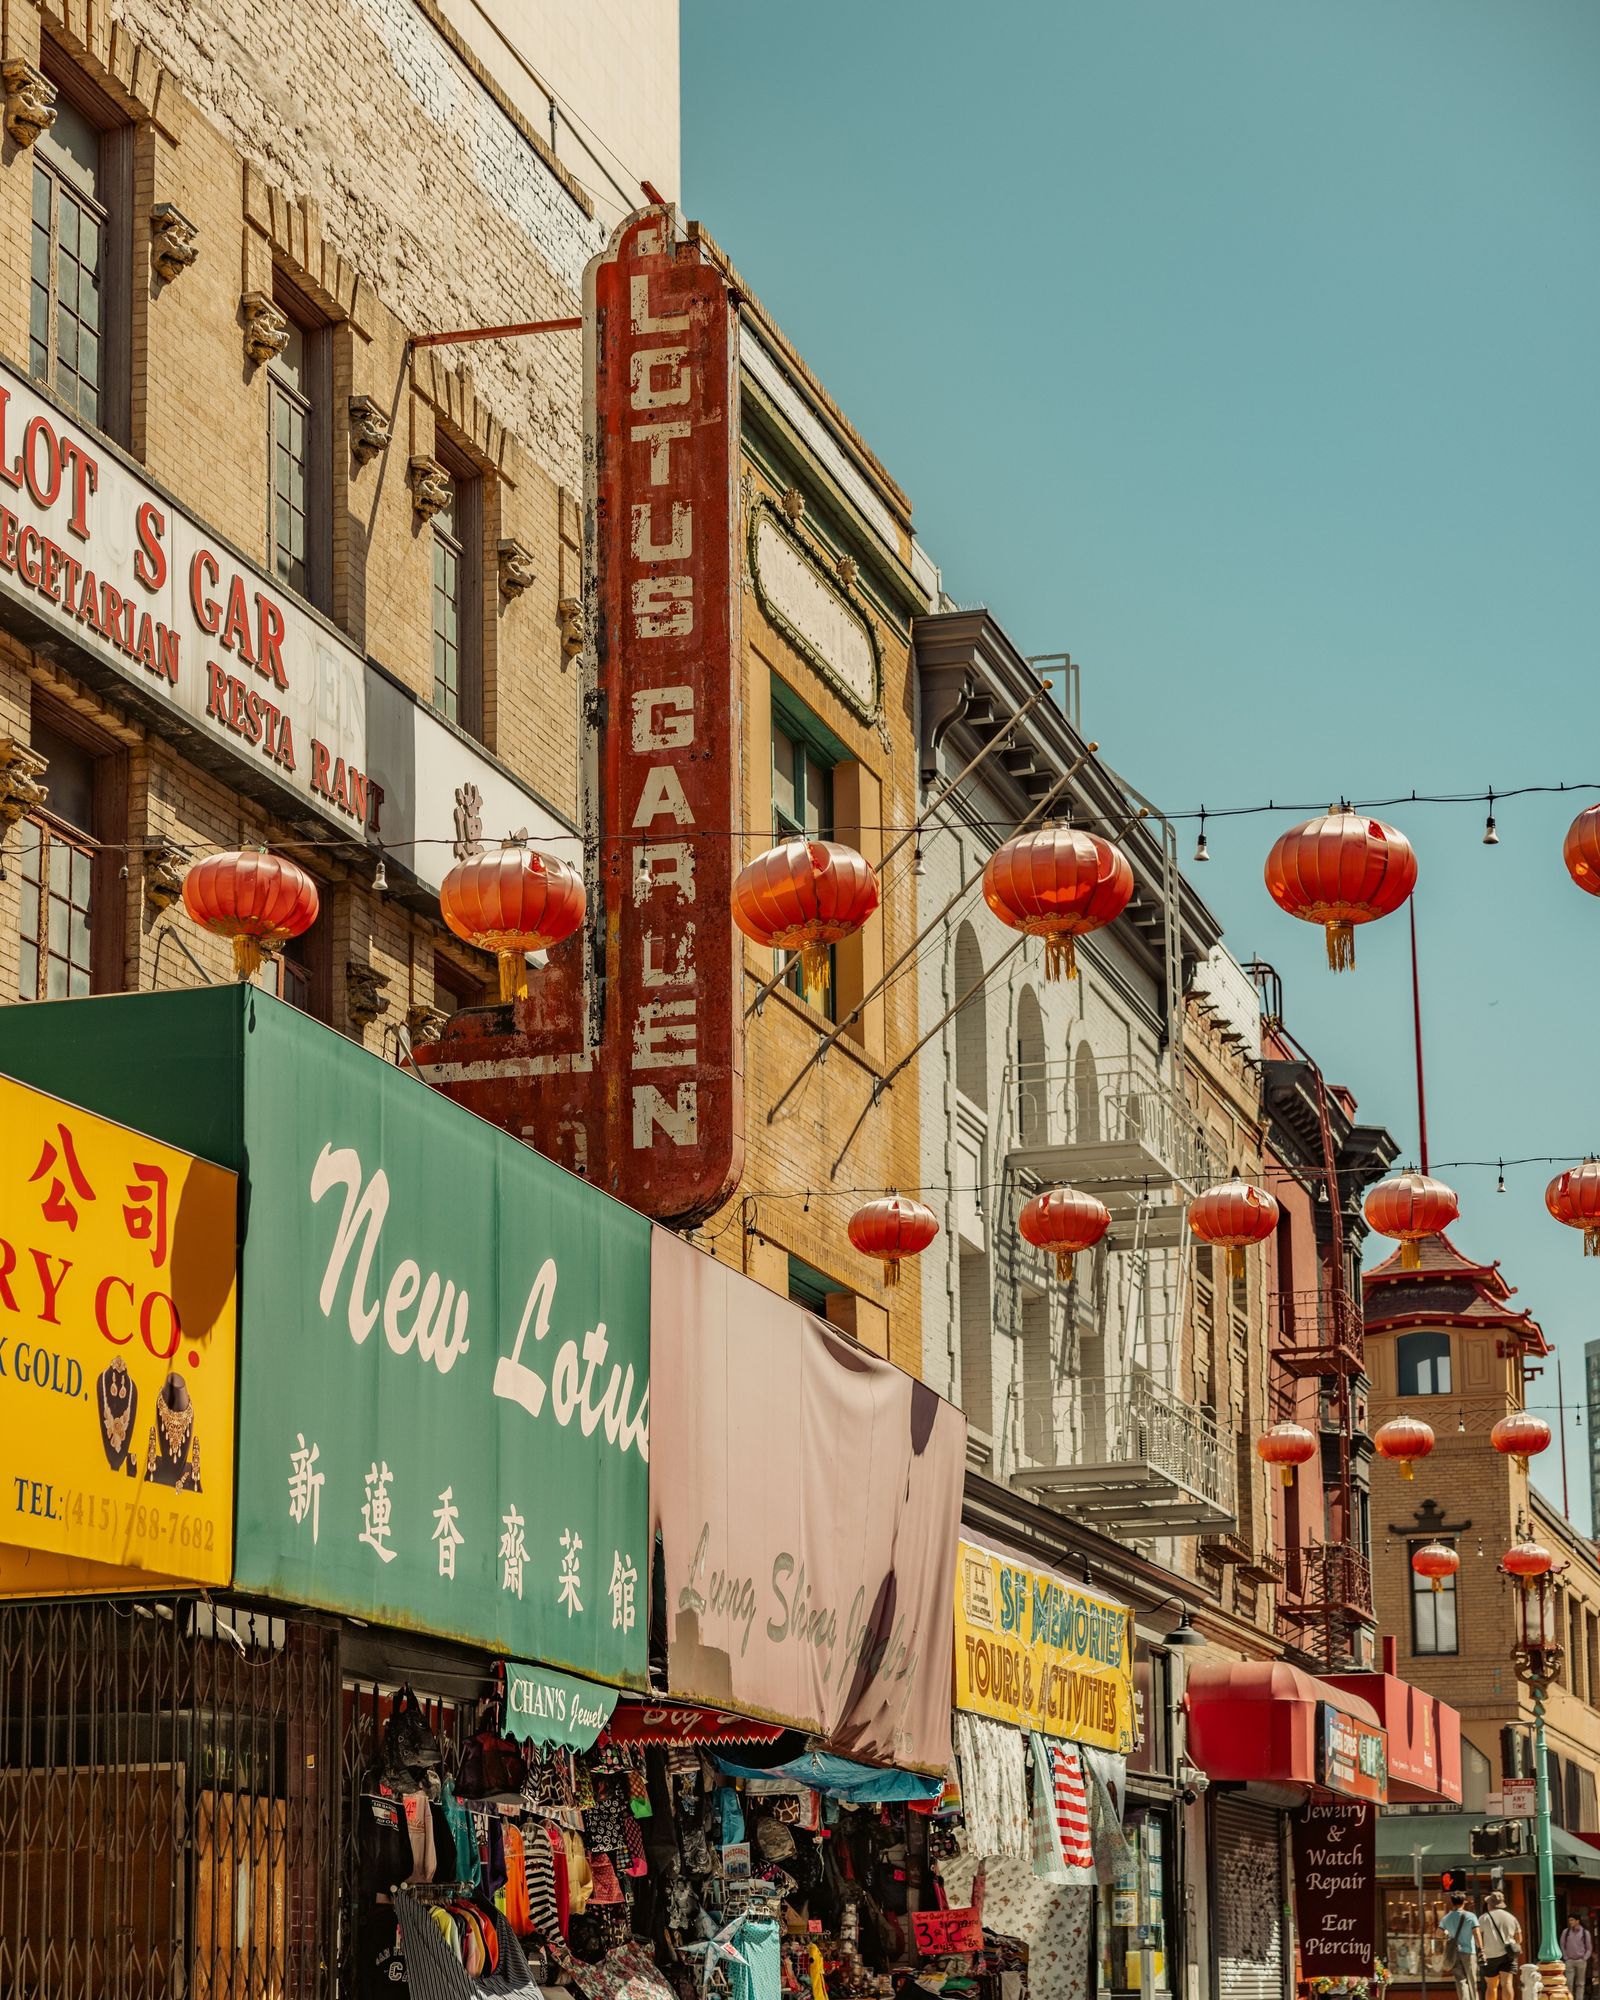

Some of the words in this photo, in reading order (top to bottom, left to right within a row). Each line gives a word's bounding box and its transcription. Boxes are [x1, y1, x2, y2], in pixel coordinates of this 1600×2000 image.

[631, 274, 692, 639] LOTUS
[27, 1122, 169, 1269] 公司
[310, 1141, 470, 1374] New
[94, 1275, 200, 1369] CO.
[14, 1342, 89, 1402] GOLD.
[123, 1502, 215, 1553] 788-7682
[1000, 1567, 1027, 1633] SF
[1031, 1580, 1125, 1669] MEMORIES
[510, 1678, 567, 1722] CHAN'S
[965, 1634, 1020, 1708] TOURS
[1023, 1655, 1035, 1712] &
[1038, 1662, 1117, 1735] ACTIVITIES
[1306, 1844, 1363, 1866] Watch
[1327, 1825, 1346, 1842] &
[1306, 1872, 1367, 1899] Repair
[916, 1922, 934, 1948] 3
[1321, 1914, 1358, 1932] Ear
[1305, 1937, 1371, 1964] Piercing
